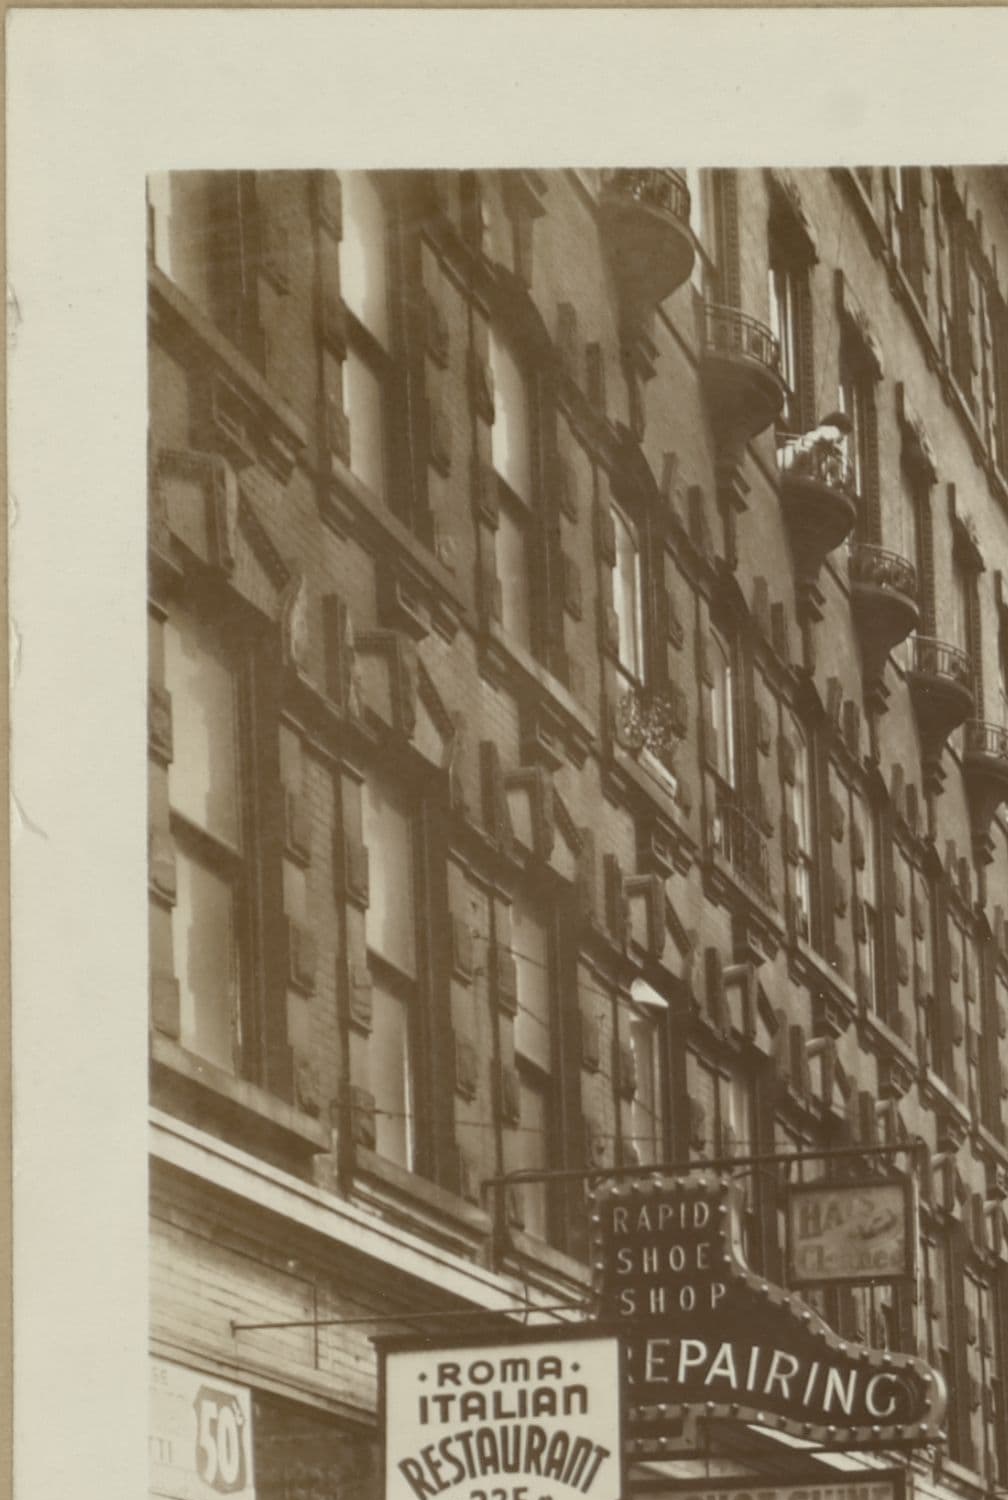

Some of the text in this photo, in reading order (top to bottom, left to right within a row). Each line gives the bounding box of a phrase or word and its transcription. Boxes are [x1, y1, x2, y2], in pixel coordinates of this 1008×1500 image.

[613, 1201, 710, 1232] RAPID
[617, 1243, 710, 1274] SHOE
[620, 1283, 726, 1315] SHOP
[437, 1356, 563, 1387] ROMA
[627, 1339, 898, 1417] EPAIRING
[419, 1385, 589, 1425] ITALIAN
